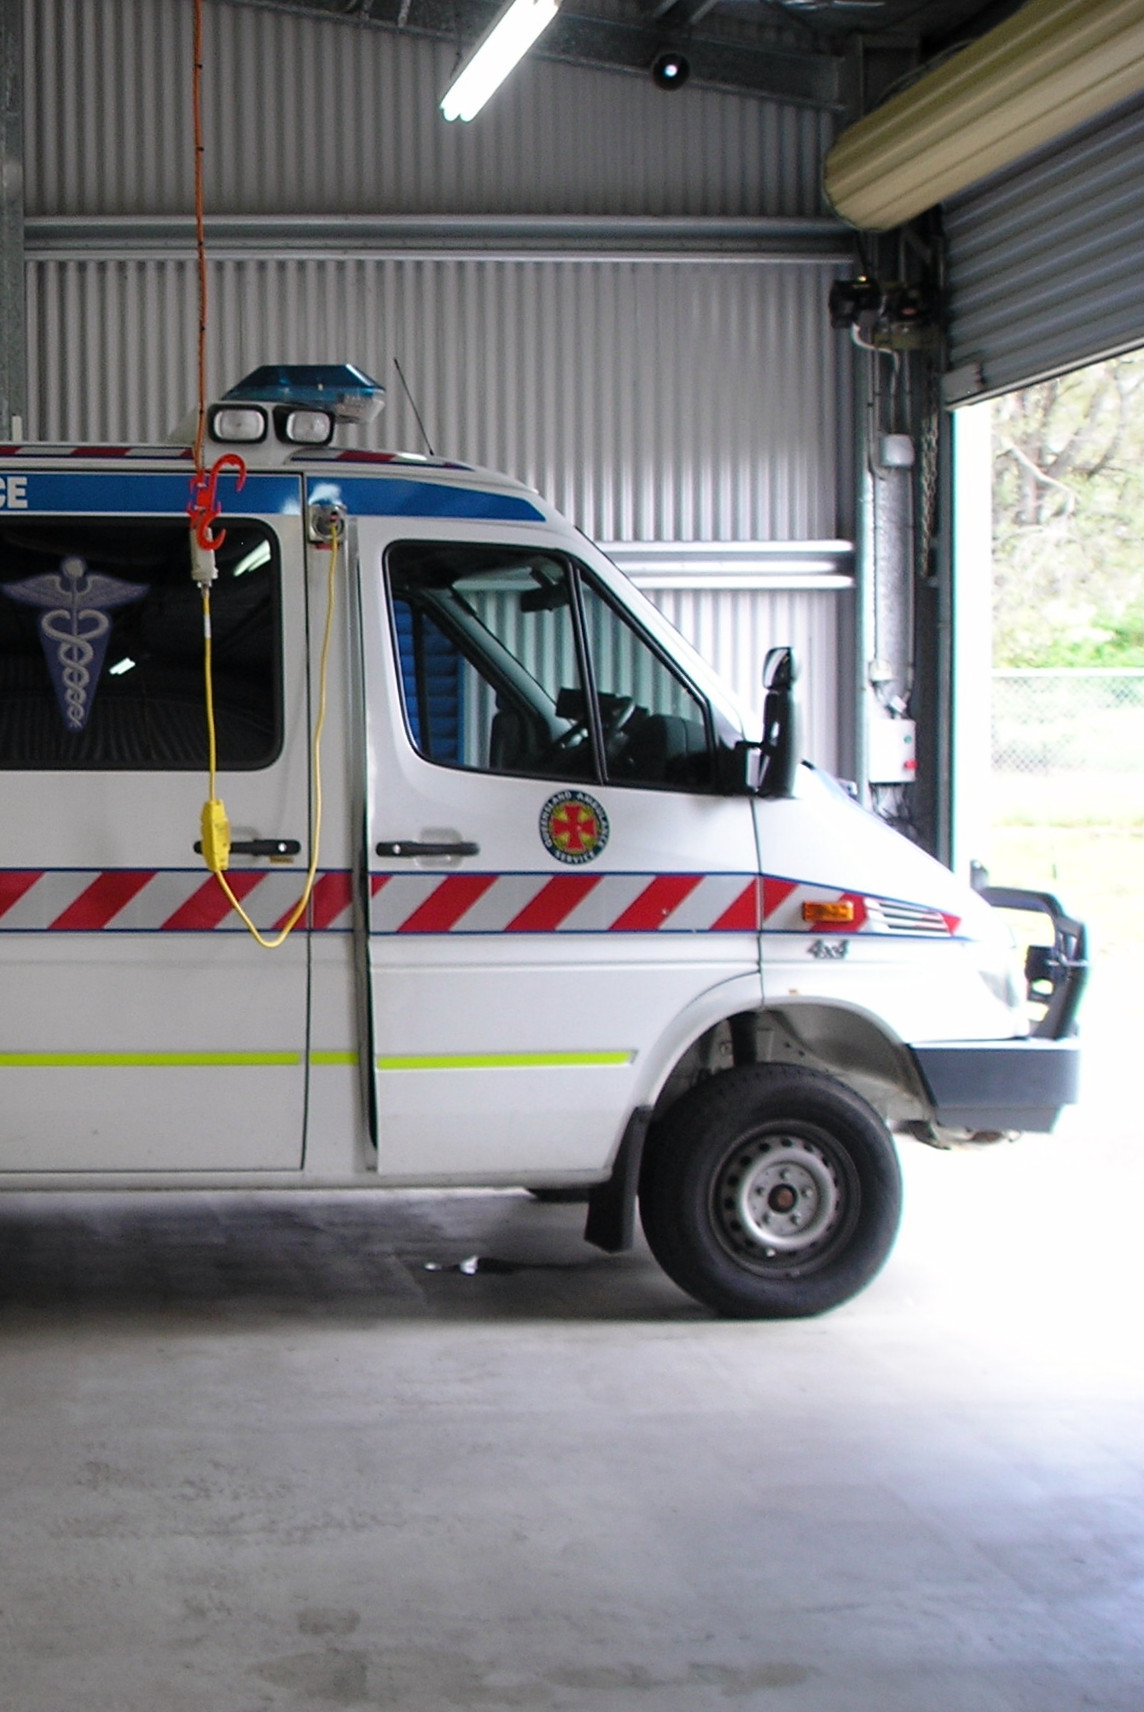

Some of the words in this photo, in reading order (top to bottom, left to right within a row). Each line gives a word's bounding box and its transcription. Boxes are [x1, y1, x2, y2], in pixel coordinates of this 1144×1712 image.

[540, 791, 572, 848] QUEENSLAND
[576, 792, 609, 847] AMBULANCE
[556, 850, 595, 863] SERVICE
